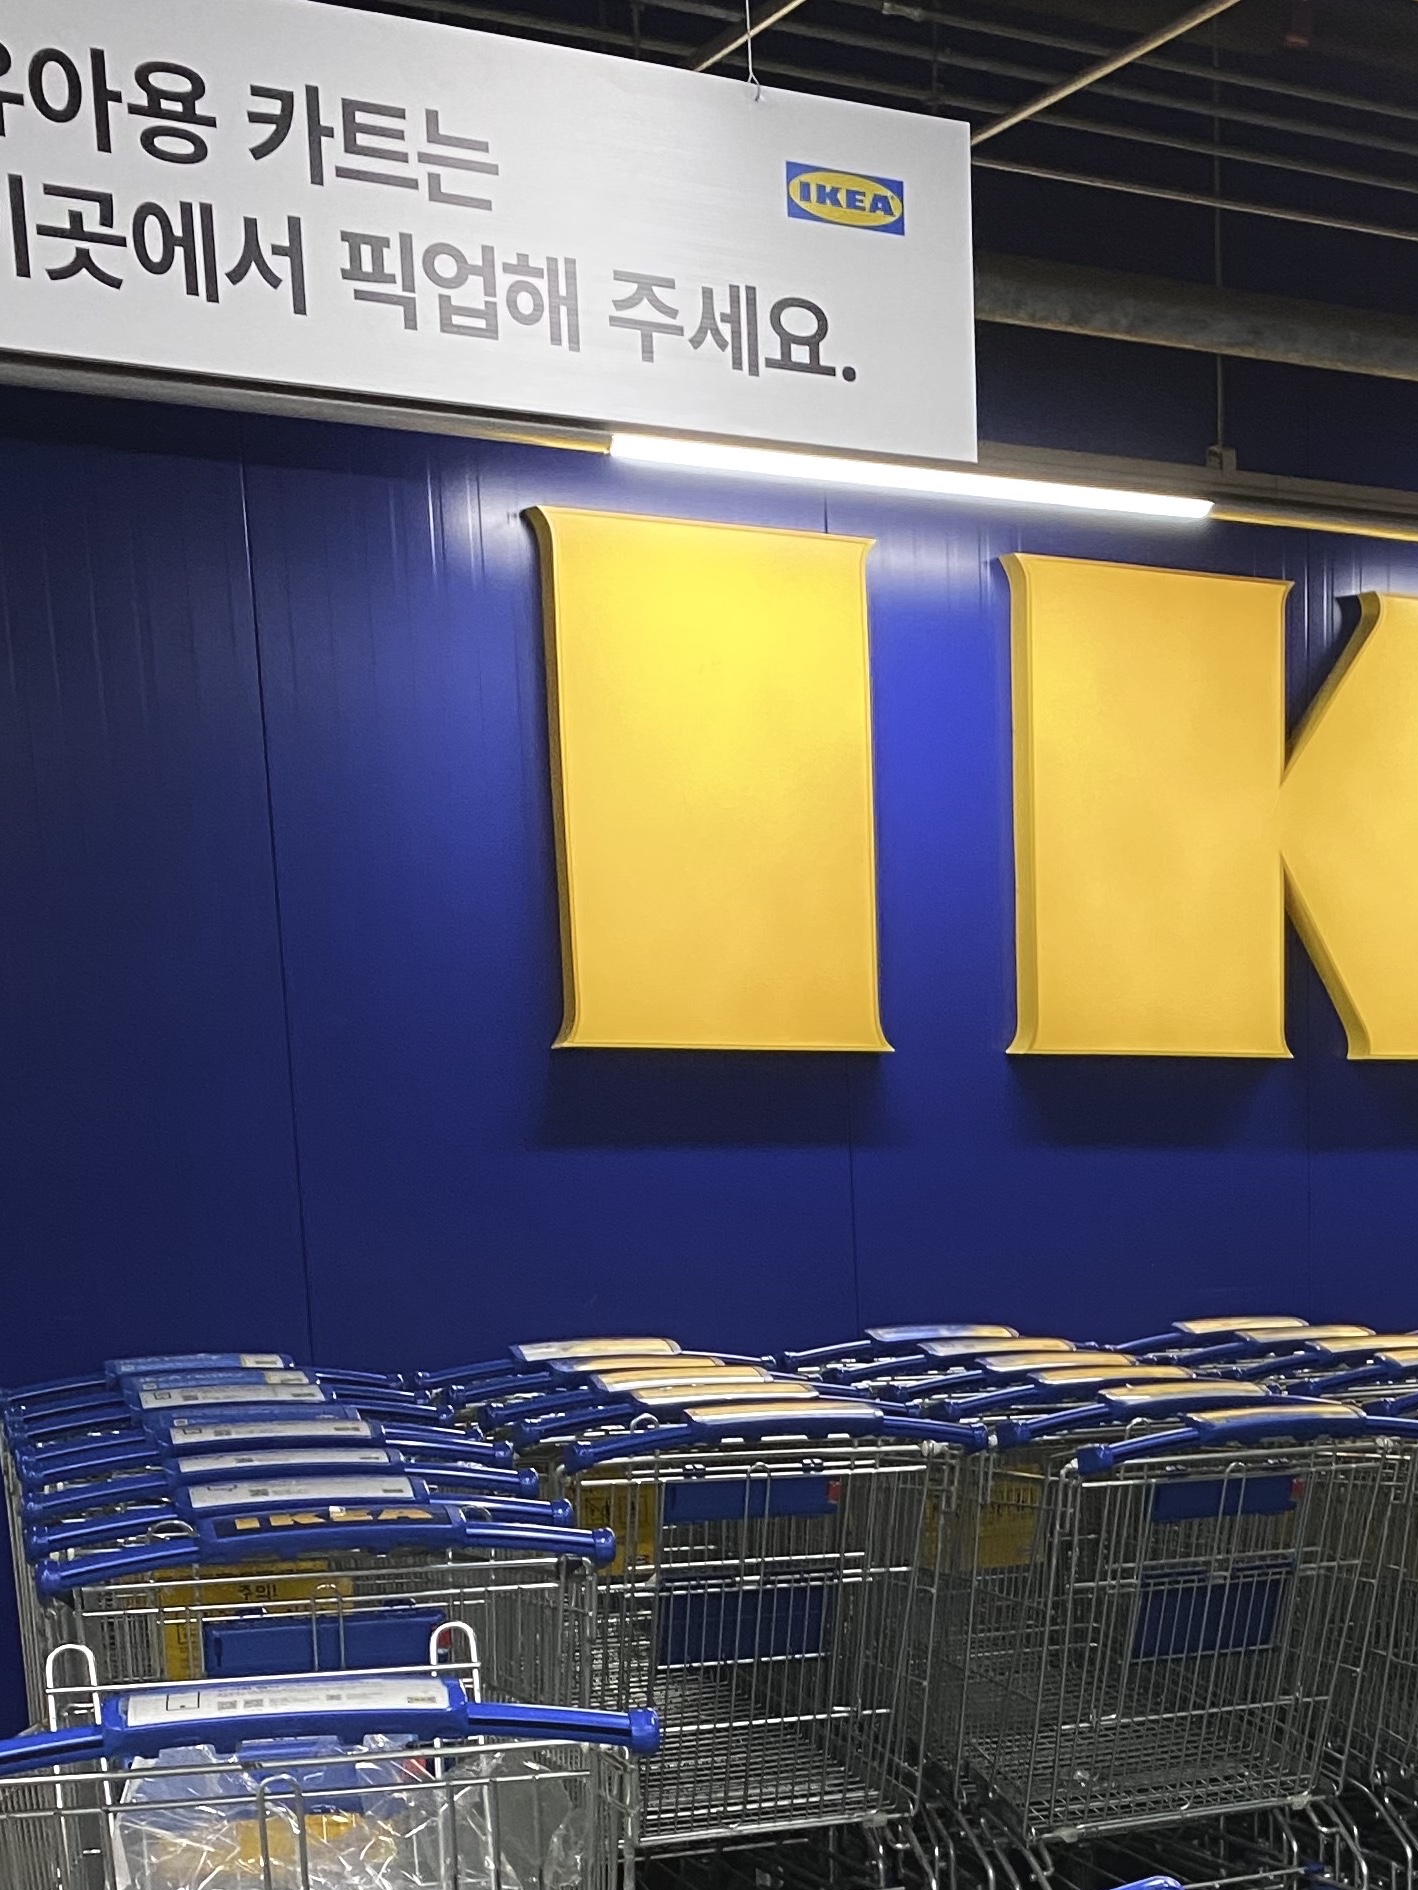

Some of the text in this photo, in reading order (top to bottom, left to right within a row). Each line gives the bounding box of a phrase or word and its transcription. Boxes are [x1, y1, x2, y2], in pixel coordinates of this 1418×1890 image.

[0, 43, 500, 212] 아용 카트는
[799, 180, 896, 218] IKEA
[340, 230, 581, 353] 픽업해
[608, 269, 857, 383] 주세요.
[234, 1506, 433, 1530] IKEA
